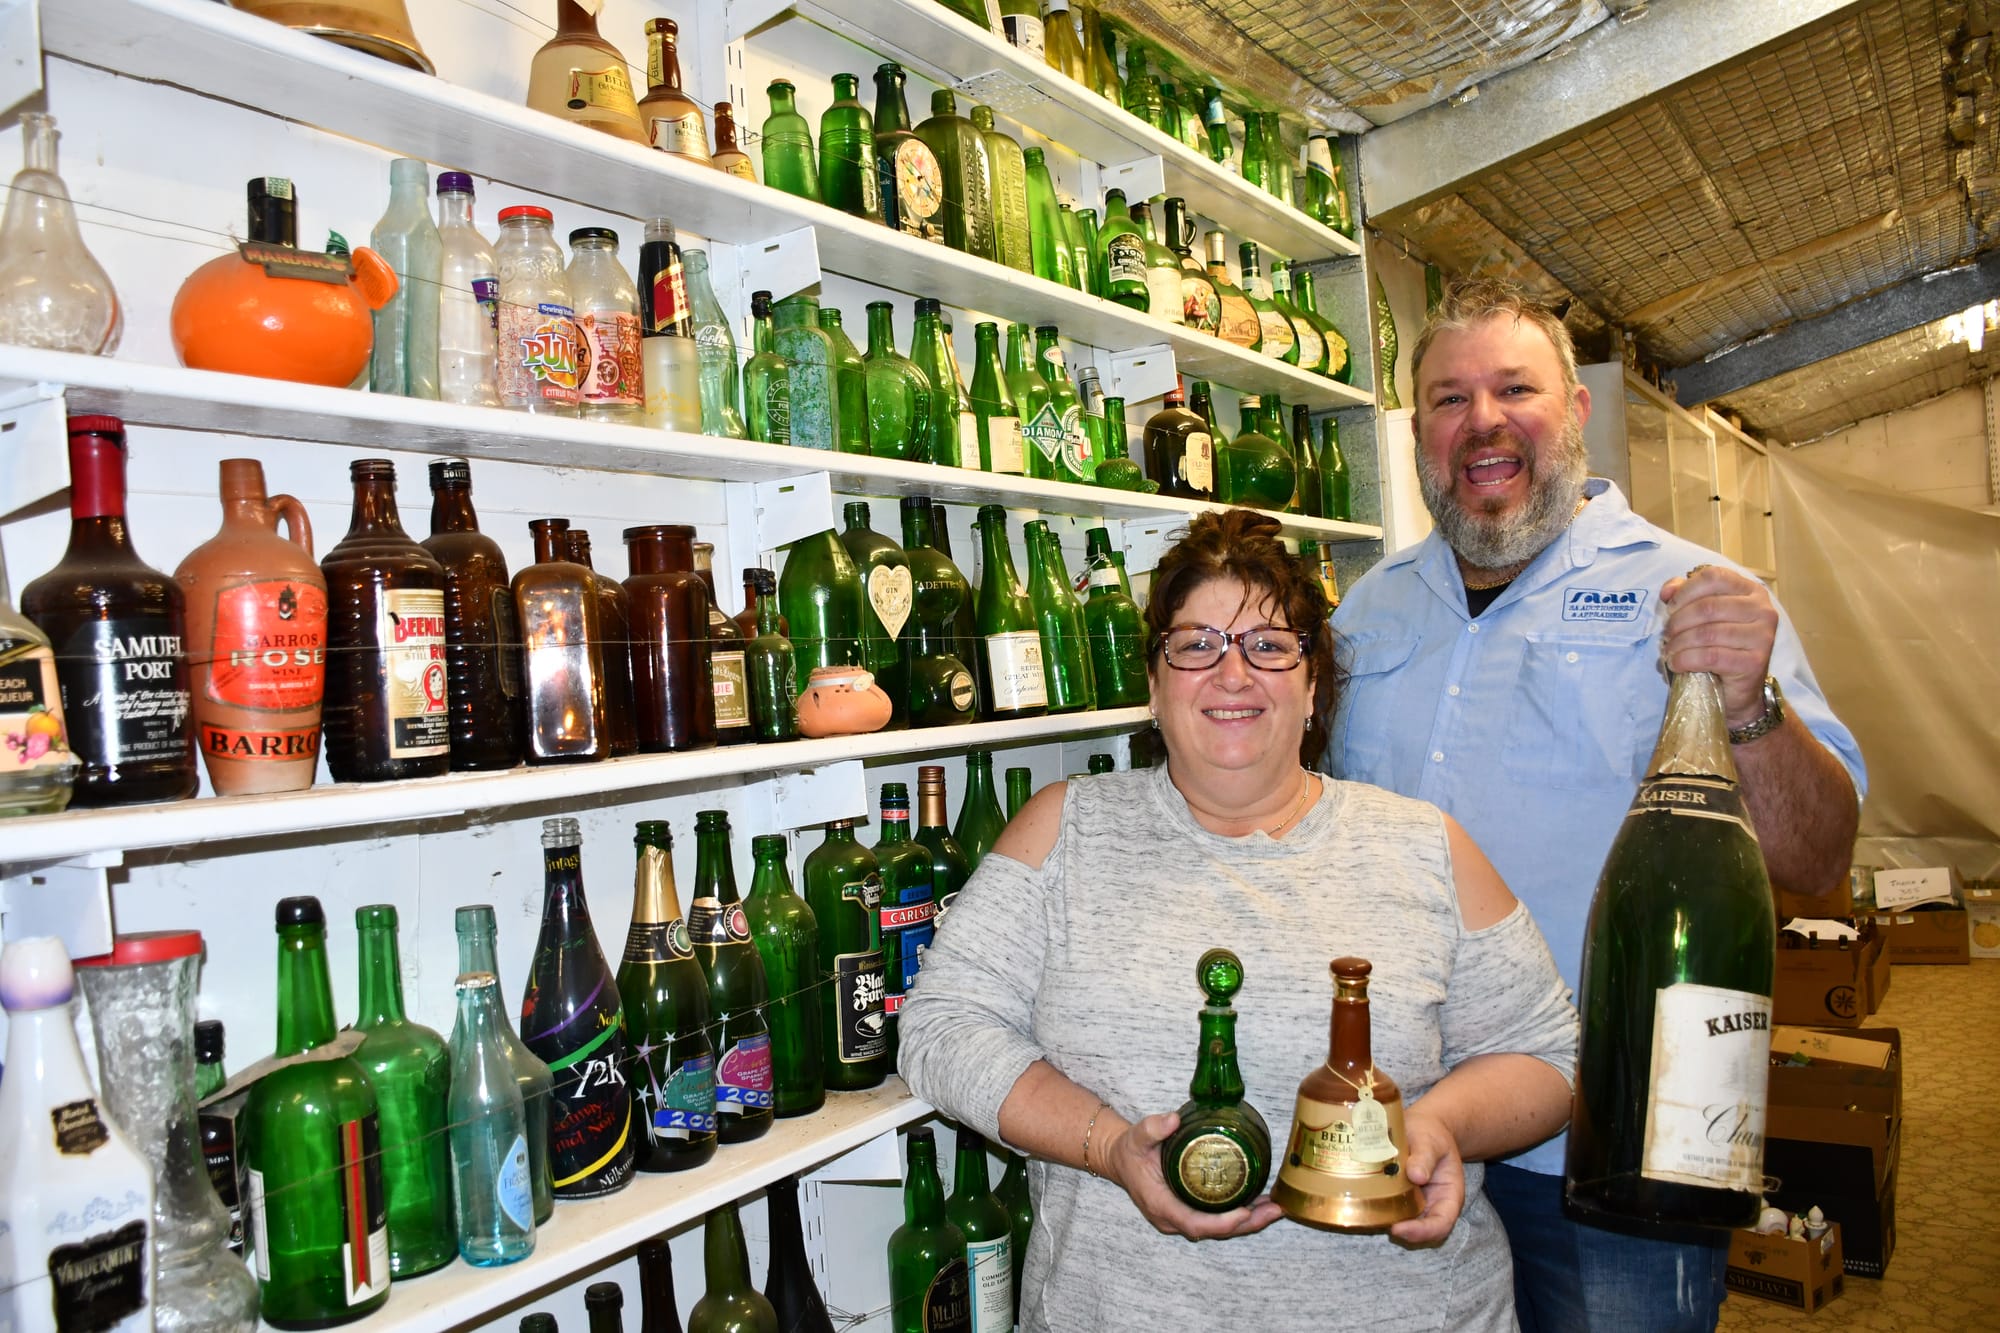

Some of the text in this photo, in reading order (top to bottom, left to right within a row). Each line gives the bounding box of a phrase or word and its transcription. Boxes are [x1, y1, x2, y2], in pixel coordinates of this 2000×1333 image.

[94, 636, 184, 660] SAMUEL
[125, 661, 173, 680] PORT
[1705, 1012, 1768, 1037] KAISER
[982, 1281, 997, 1289] OLD
